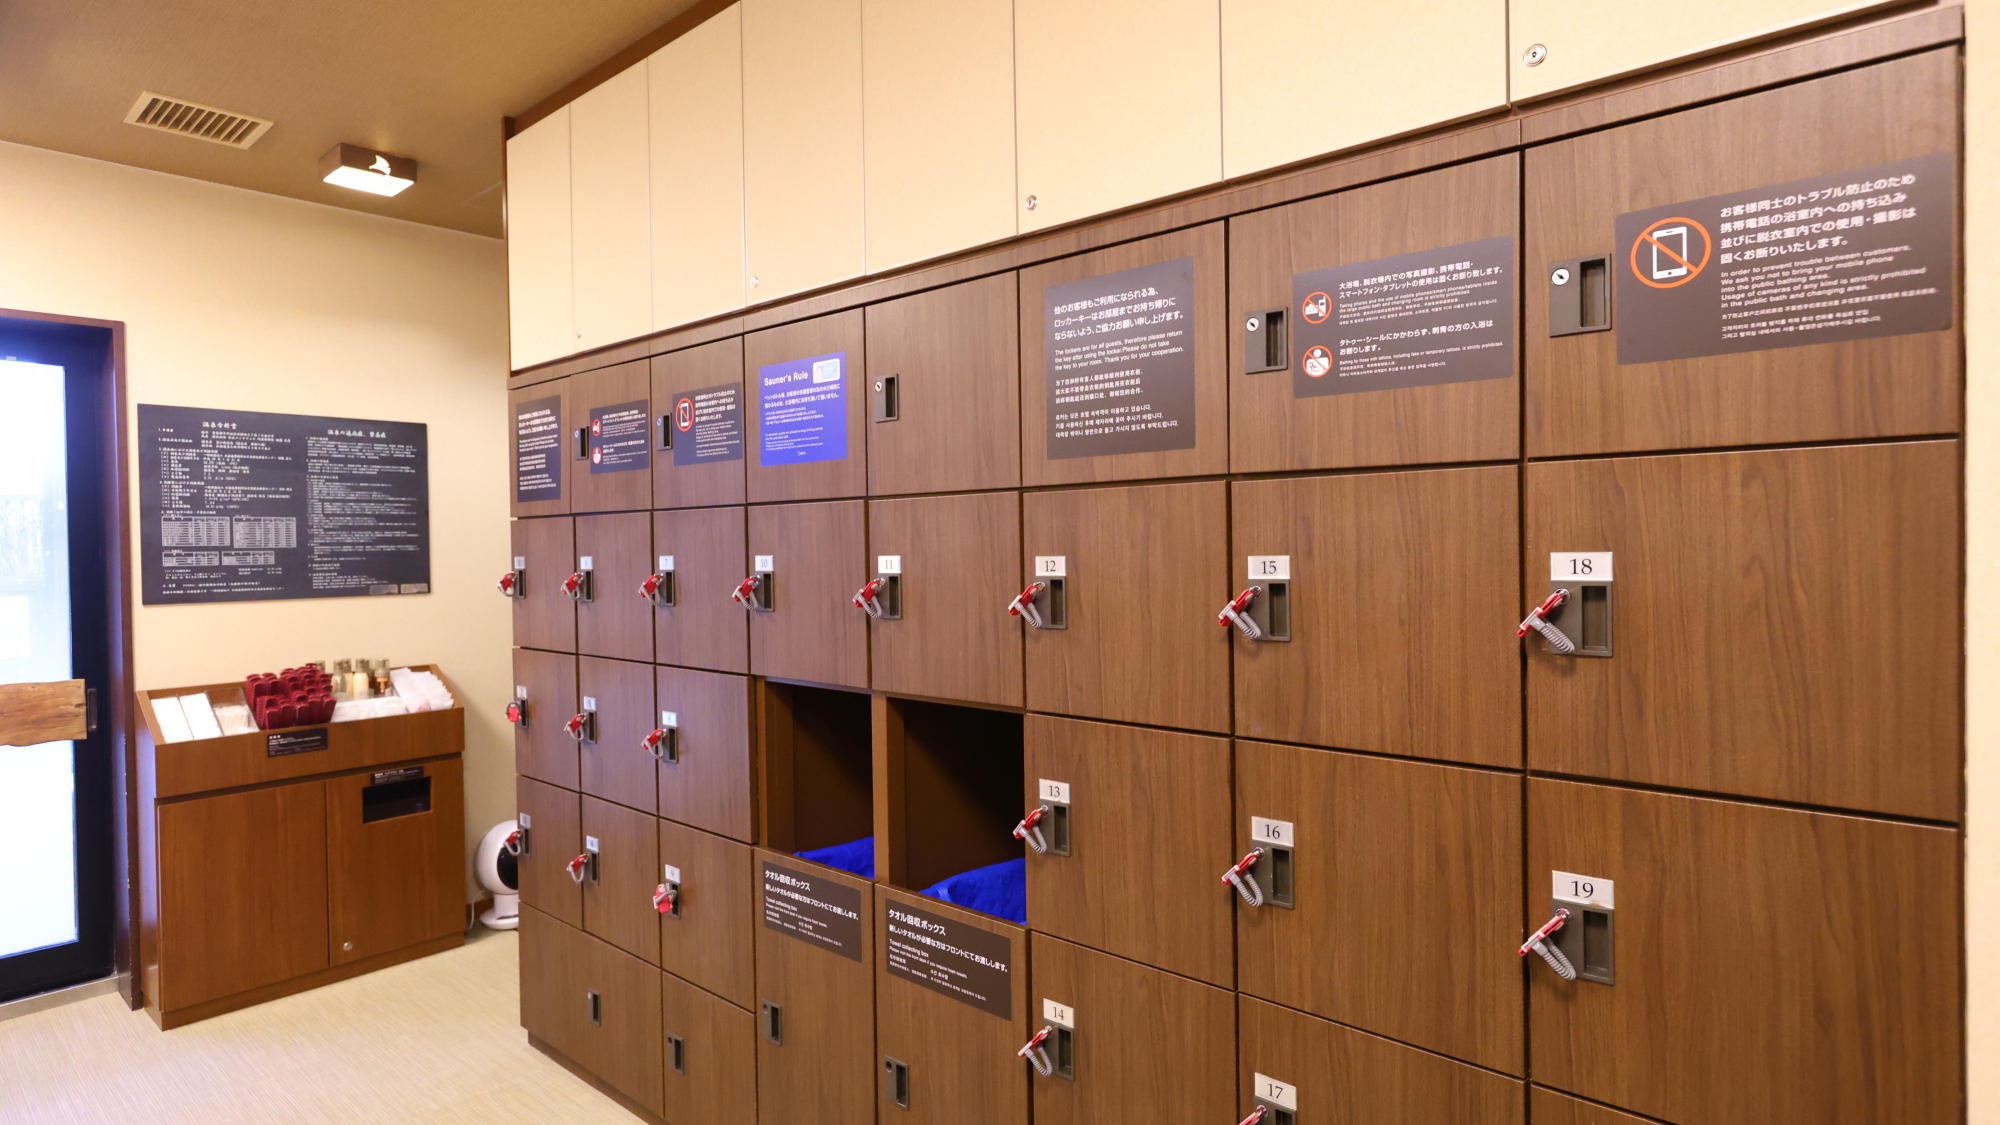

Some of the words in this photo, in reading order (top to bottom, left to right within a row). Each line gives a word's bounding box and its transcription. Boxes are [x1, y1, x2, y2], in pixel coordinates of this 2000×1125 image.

[1720, 172, 1915, 218] お客様同士のトラブル防止のため
[1720, 191, 1906, 233] 携帯電話の浴室内への持ち込み
[1720, 206, 1916, 249] 並びに脱衣室内での使用・撮影は
[1720, 234, 1848, 264] 固くお断りいたします。
[1730, 268, 1750, 276] order
[1762, 261, 1792, 272] prevent
[1793, 257, 1822, 266] trouble
[1824, 252, 1860, 262] between
[1791, 266, 1813, 276] bring
[1814, 264, 1833, 273] your
[1835, 259, 1864, 269] mobile
[1866, 255, 1894, 266] phone
[1721, 291, 1745, 301] Usage
[1756, 286, 1790, 296] cameras
[1802, 283, 1818, 291] any
[1820, 279, 1838, 287] kind
[1849, 273, 1878, 284] strictly
[1880, 267, 1926, 280] prohibited
[1751, 280, 1774, 290] public
[1776, 275, 1806, 286] bathing
[1053, 285, 1158, 315] 他のお客様もご利用になられる為、
[1744, 296, 1767, 306] public
[1806, 286, 1844, 298] changing
[1054, 296, 1175, 328] ロッカーキーはお部屋までお持ち帰りに
[1054, 308, 1183, 340] ならないよう、ご協力お願い申し上げます。
[1339, 319, 1493, 346] タトゥー・シールにかかわらず、刺青の方の入浴は
[1064, 345, 1081, 354] lockers
[1124, 334, 1146, 344] therefore
[1148, 331, 1165, 342] please
[1166, 328, 1182, 337] return
[1339, 343, 1380, 355] お断りします。
[1083, 351, 1096, 360] using
[1103, 355, 1119, 363] Thank
[764, 373, 791, 385] Sauner's
[793, 370, 808, 380] Rule
[760, 558, 768, 568] 10
[884, 559, 893, 570] 11
[1044, 560, 1056, 572] 12
[1260, 560, 1277, 575] 15
[1570, 558, 1592, 575] 18
[1048, 784, 1060, 798] 13
[1264, 824, 1280, 840] 16
[1570, 880, 1594, 898] 19
[888, 908, 945, 936] タオル回収ボックス
[1052, 1006, 1064, 1020] 14
[1267, 1083, 1284, 1099] 17
